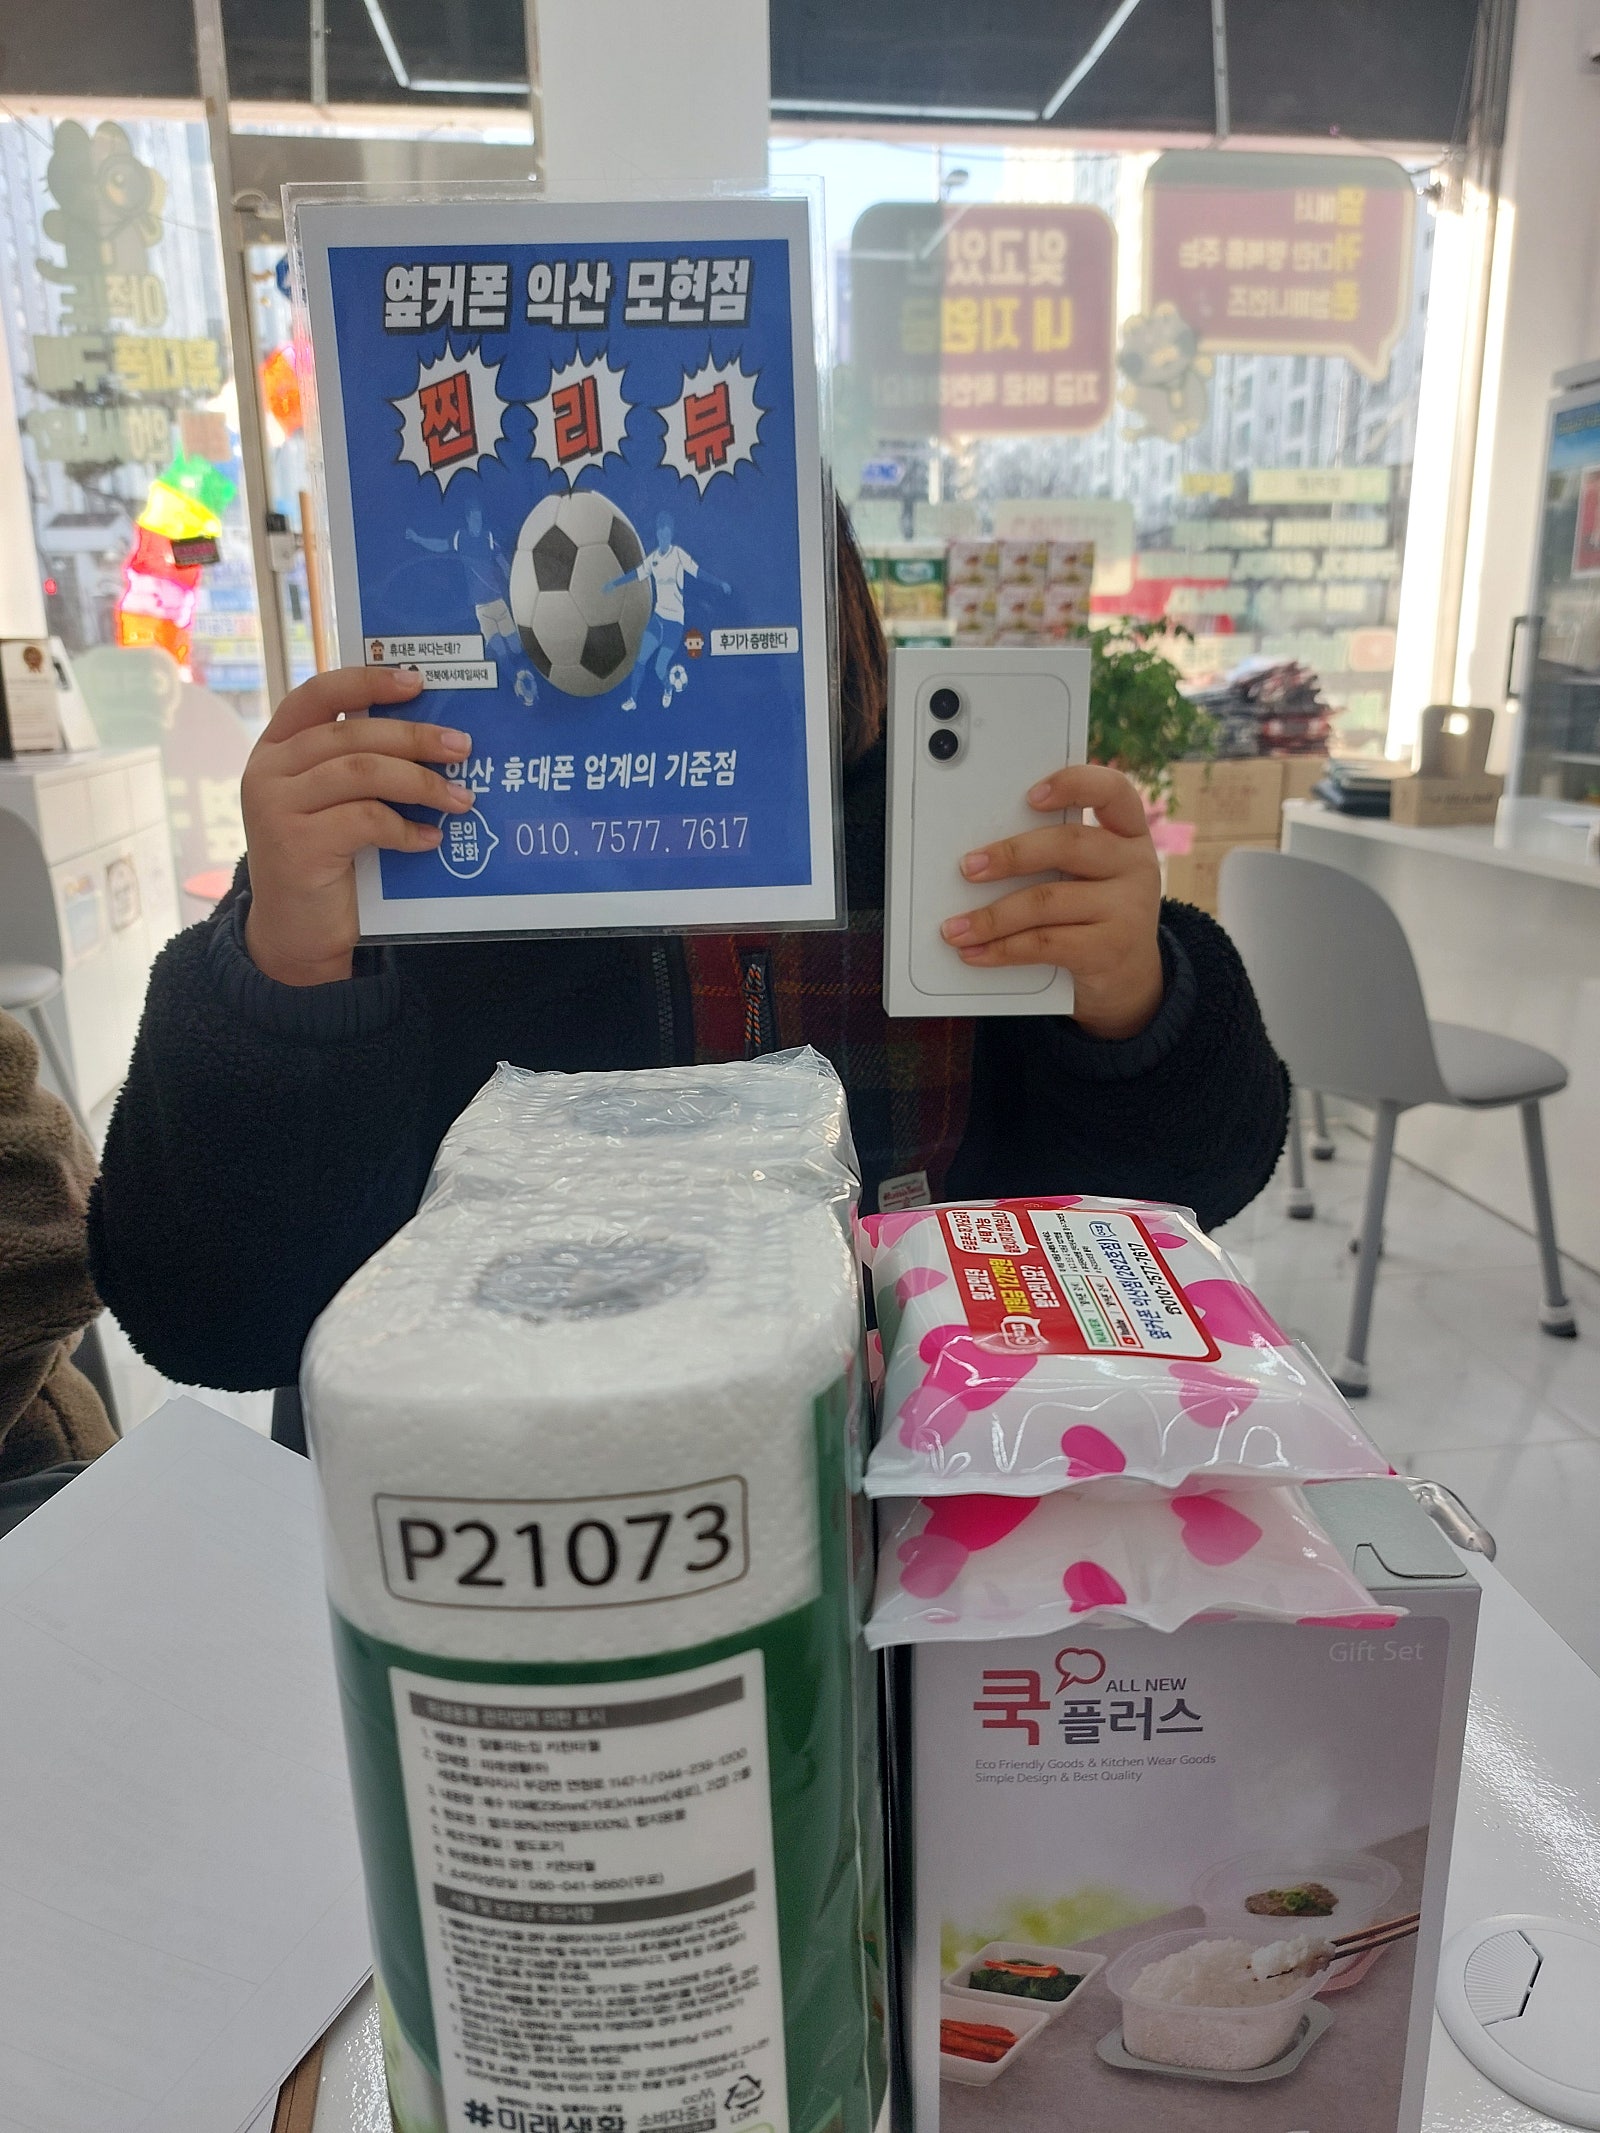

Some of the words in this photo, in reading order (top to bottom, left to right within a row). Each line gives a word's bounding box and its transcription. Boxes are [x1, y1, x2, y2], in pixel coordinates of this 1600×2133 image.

[383, 263, 508, 329] 옆커폰
[526, 260, 612, 327] 익산
[624, 258, 751, 325] 모현점
[418, 371, 479, 471] 찐
[552, 376, 603, 465] 리
[685, 382, 735, 472] 뷰
[390, 643, 416, 656] 휴대폰
[501, 755, 575, 793] 휴대폰
[585, 753, 657, 790] 업계의
[664, 749, 738, 788] 기준점
[450, 821, 478, 842] 문의
[516, 822, 579, 857] 010.
[591, 821, 671, 853] 7577.
[683, 817, 749, 849] 7617
[451, 842, 480, 863] 전화
[974, 1217, 998, 1243] 선택가능
[1095, 1238, 1154, 1305] 익산점(282호점)
[1127, 1243, 1177, 1305] 010-7577-7617
[999, 1289, 1032, 1312] 지원금
[1135, 1309, 1172, 1339] 옆커폰
[398, 1502, 732, 1590] P21073
[1329, 1642, 1376, 1663] Gift
[1383, 1641, 1424, 1661] Set
[1105, 1679, 1141, 1693] ALL
[1146, 1677, 1187, 1692] NEW
[973, 1669, 1051, 1746] 쿡
[1058, 1697, 1204, 1745] 플러스
[975, 1760, 996, 1769] Eco
[1000, 1759, 1045, 1771] Friendly
[1048, 1758, 1084, 1768] Goods
[1089, 1758, 1097, 1767] &
[1101, 1757, 1144, 1767] Kitchen
[1146, 1756, 1177, 1766] Wear
[1180, 1754, 1216, 1765] Goods
[975, 1773, 1014, 1784] Simple
[1017, 1773, 1056, 1784] Design
[1060, 1772, 1069, 1782] &
[1073, 1771, 1098, 1781] Best
[1101, 1771, 1143, 1782] Quality
